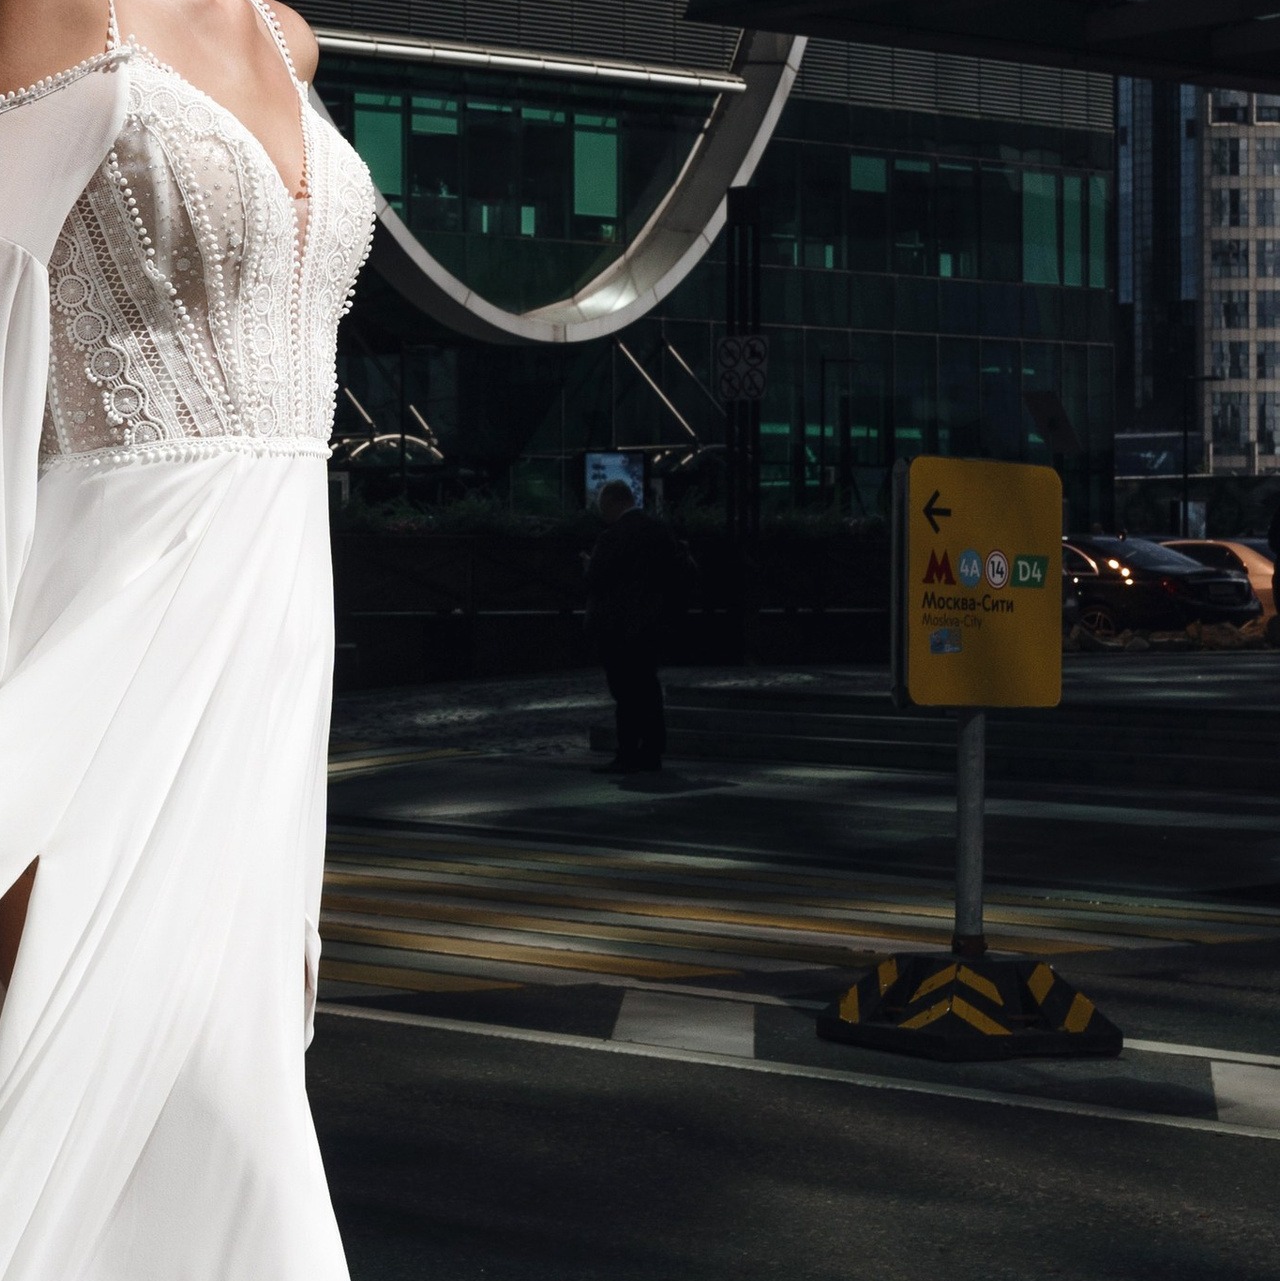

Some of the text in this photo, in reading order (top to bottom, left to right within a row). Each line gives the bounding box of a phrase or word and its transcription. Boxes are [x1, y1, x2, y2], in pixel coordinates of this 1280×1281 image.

[990, 561, 1004, 578] 14
[1017, 561, 1042, 583] D4
[922, 592, 1014, 613] Москва-Сити
[922, 613, 982, 630] Moskva-City
